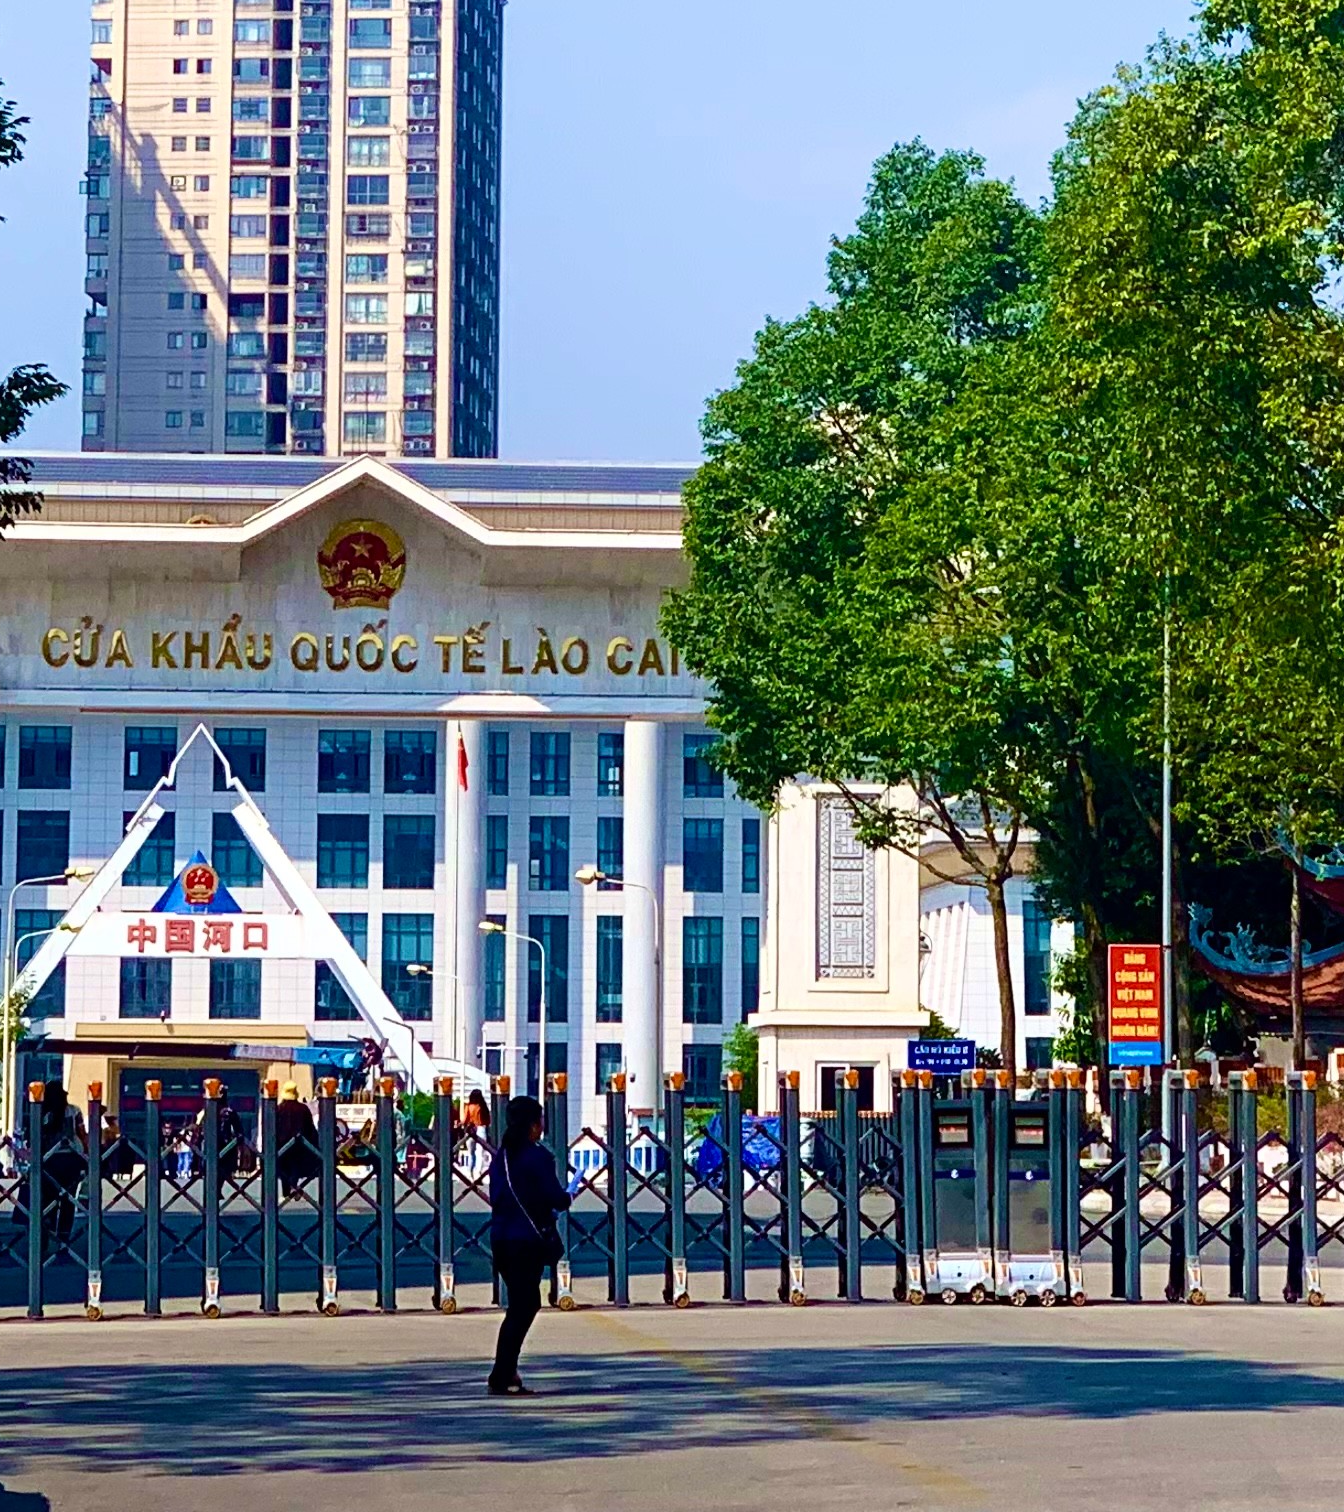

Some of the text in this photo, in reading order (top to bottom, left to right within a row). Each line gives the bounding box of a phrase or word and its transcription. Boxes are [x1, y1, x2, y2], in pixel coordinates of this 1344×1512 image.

[42, 616, 133, 668] CỬA
[150, 613, 273, 671] KHẨU
[290, 618, 418, 673] QUỐC
[433, 621, 491, 674] TẾ
[501, 627, 588, 675] LÀO
[127, 918, 268, 954] 中国河口
